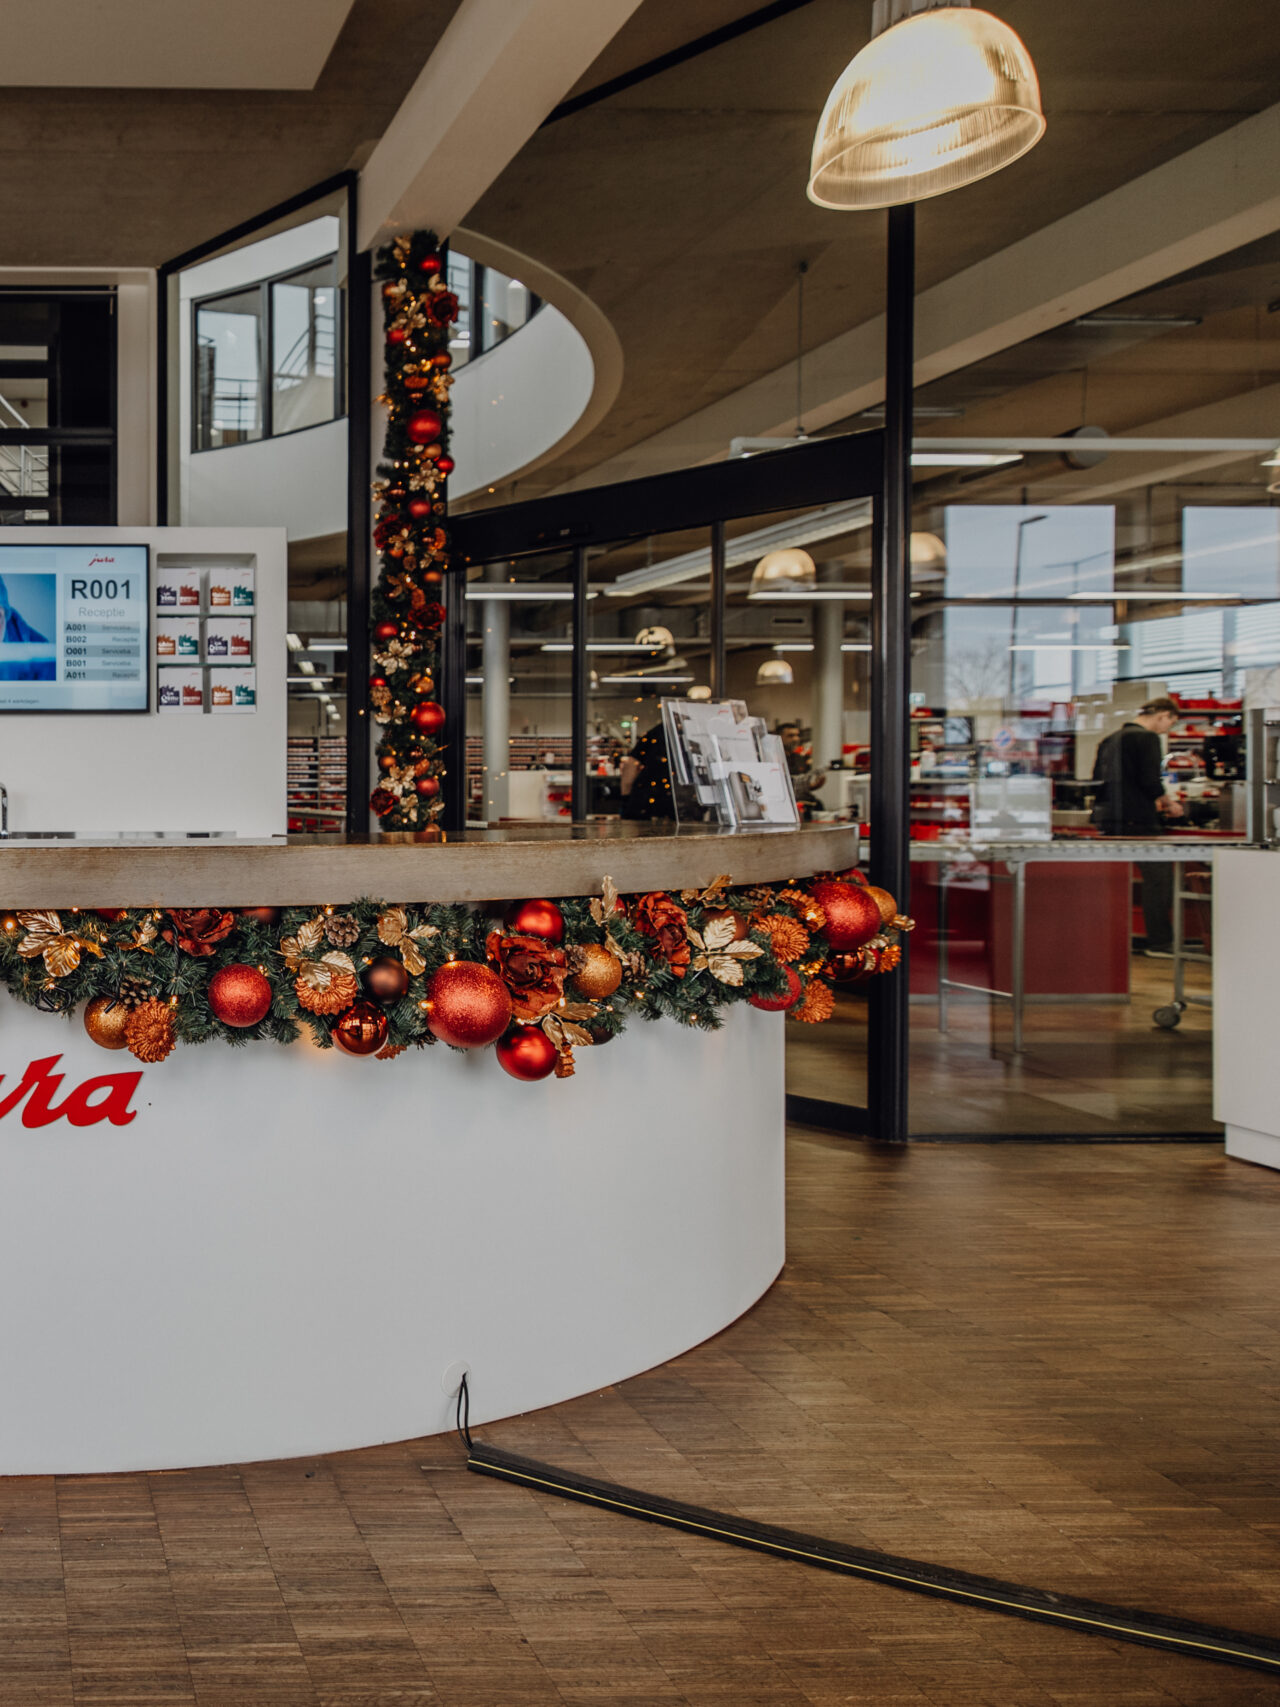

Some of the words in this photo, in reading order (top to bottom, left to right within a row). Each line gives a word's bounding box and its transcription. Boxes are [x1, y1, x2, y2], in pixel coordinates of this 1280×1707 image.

[88, 553, 115, 567] jura
[71, 579, 130, 600] R001
[78, 607, 125, 618] Receptie
